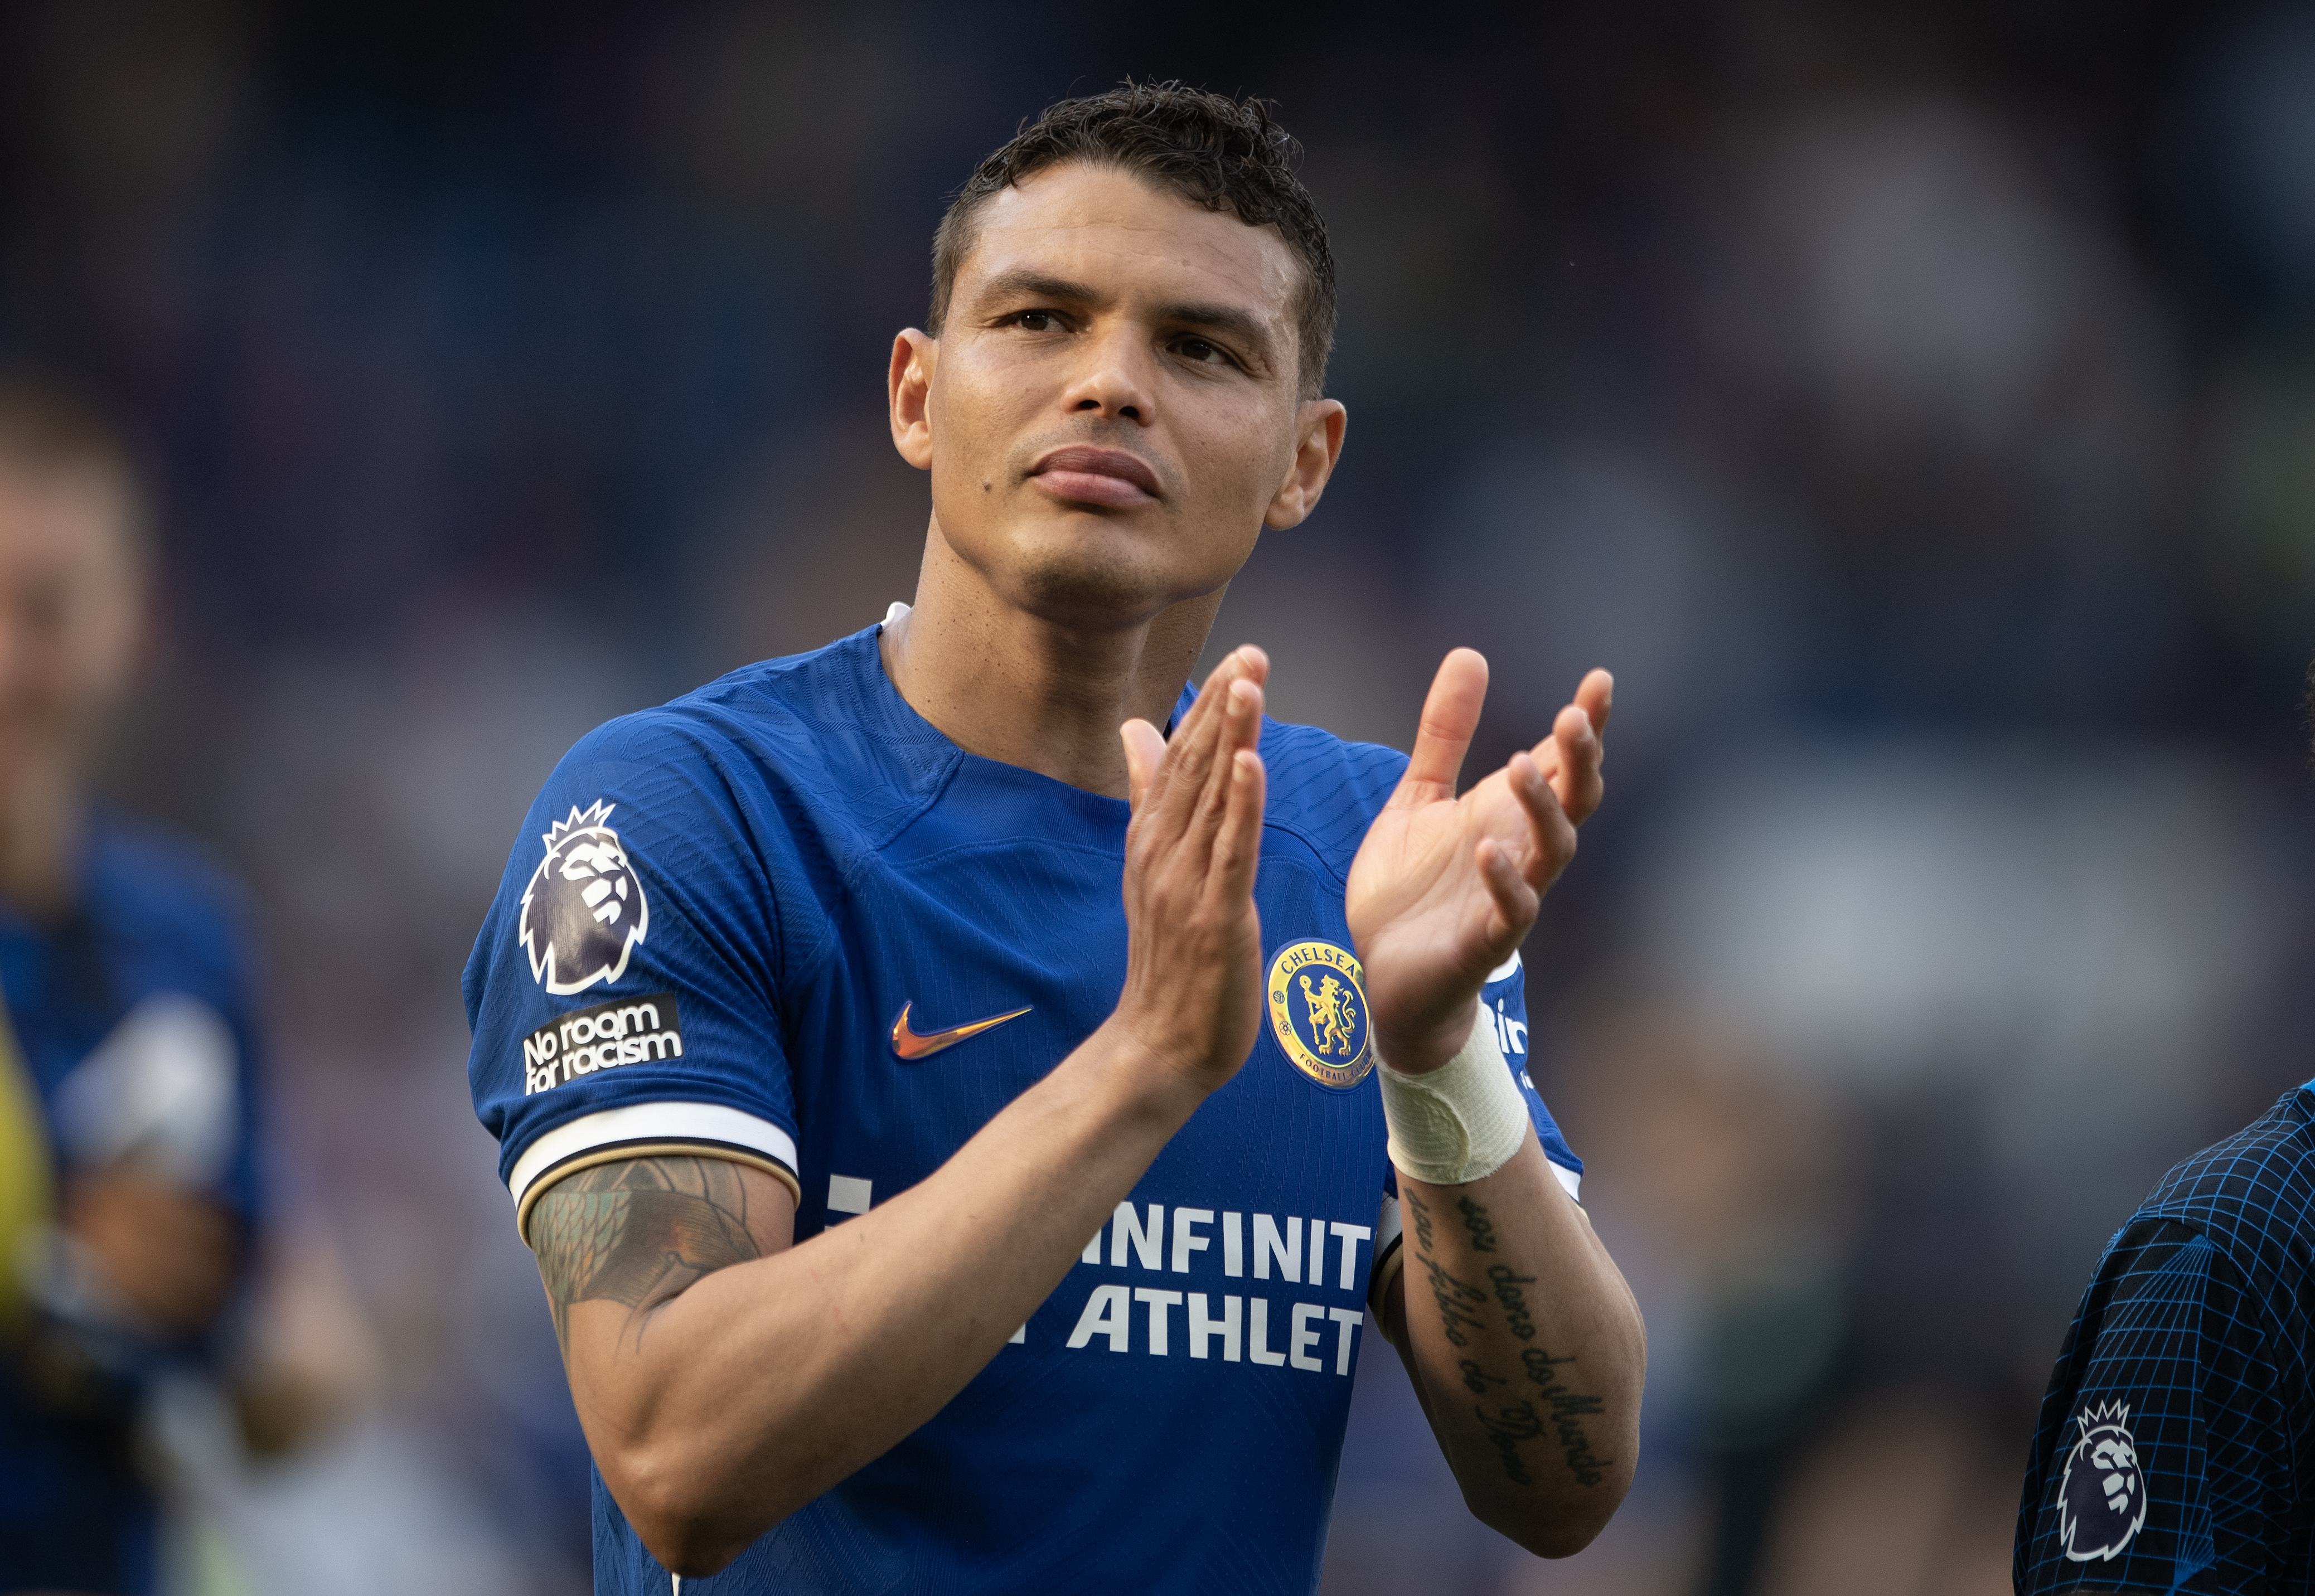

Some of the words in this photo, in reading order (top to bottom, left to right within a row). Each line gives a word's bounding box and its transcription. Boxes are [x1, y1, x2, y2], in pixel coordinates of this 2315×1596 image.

[1281, 947, 1355, 977] CHELSEA
[523, 1032, 558, 1073] No
[560, 1003, 660, 1051] room
[525, 1060, 559, 1096] for
[562, 1030, 683, 1081] racism
[1299, 1053, 1348, 1081] FOOTBALL
[1351, 1055, 1370, 1077] CLUB
[1066, 1284, 1364, 1376] ATHLET
